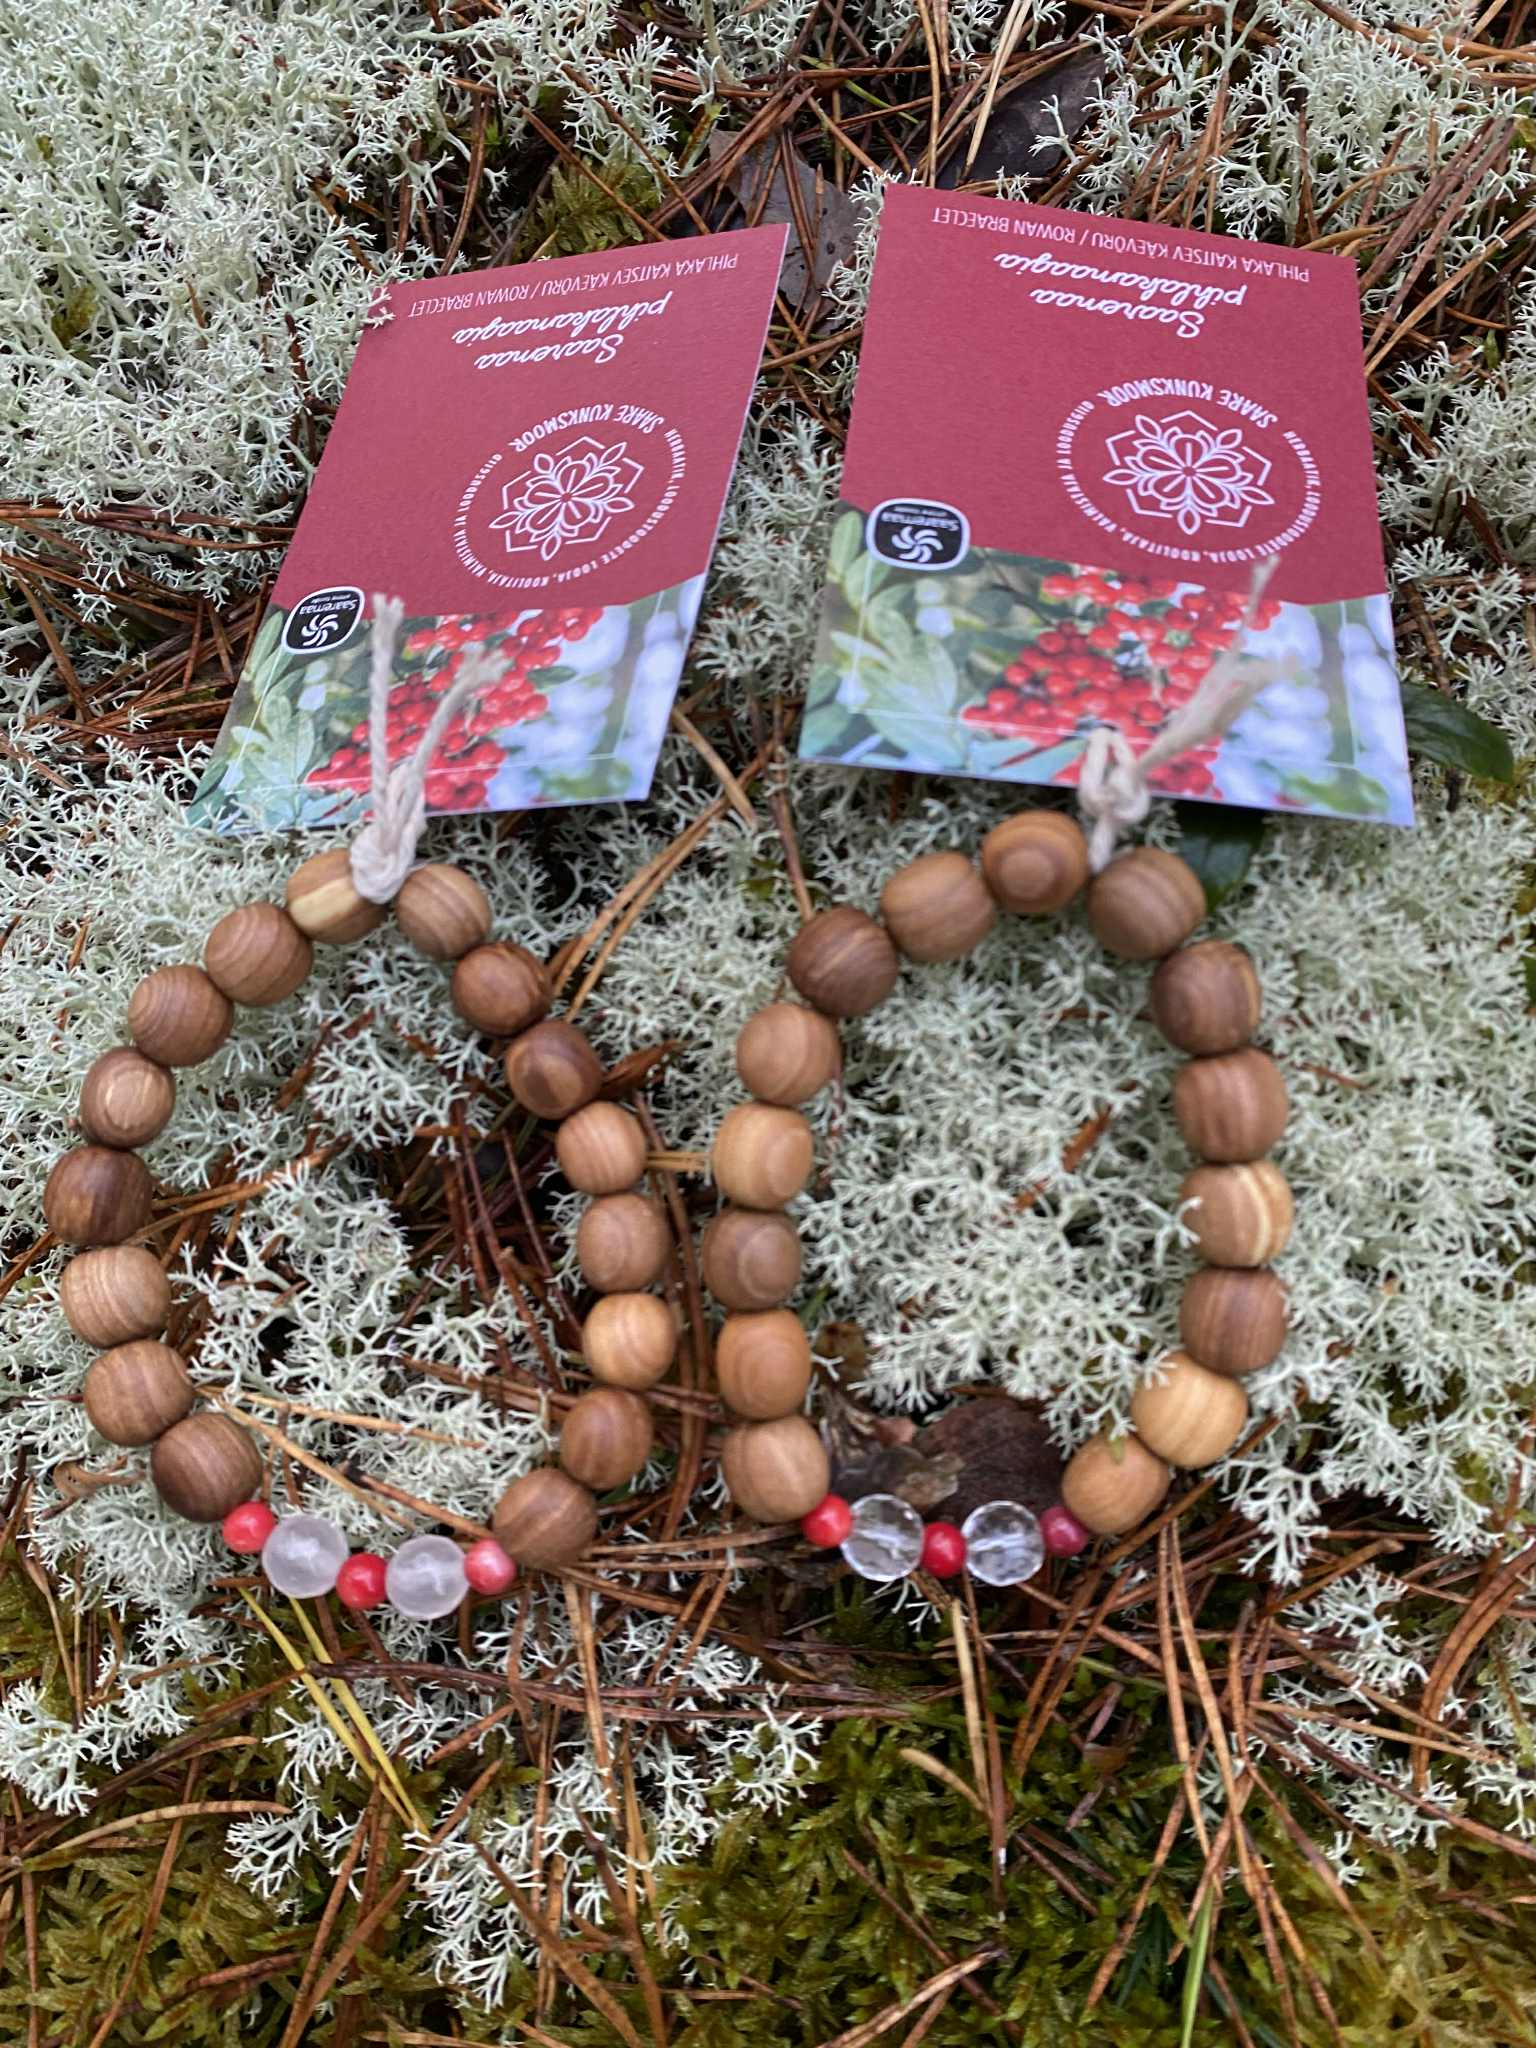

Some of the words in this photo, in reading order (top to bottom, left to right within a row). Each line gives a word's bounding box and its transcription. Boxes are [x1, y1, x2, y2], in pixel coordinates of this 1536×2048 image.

[932, 207, 1009, 233] BRAECLET
[1013, 219, 1076, 244] ROWAN
[677, 253, 738, 276] PIHLAKA
[1173, 245, 1237, 270] KAITSEV
[1242, 255, 1310, 283] PIHLAKA
[612, 262, 671, 286] KAITSEV
[994, 252, 1248, 309] pihlakamaagia
[408, 291, 479, 318] BRAECLET
[480, 284, 529, 305] ROWAN
[451, 290, 673, 347] pihlakamaagia
[1030, 287, 1205, 339] Saaremaa
[474, 333, 624, 370] Saaremaa
[1097, 377, 1214, 407] KUNKSMOOR
[613, 404, 664, 434] SAARE
[1216, 389, 1278, 428] SAARE
[507, 403, 614, 452] KUNKSMOOR
[300, 599, 358, 615] Saaremaa
